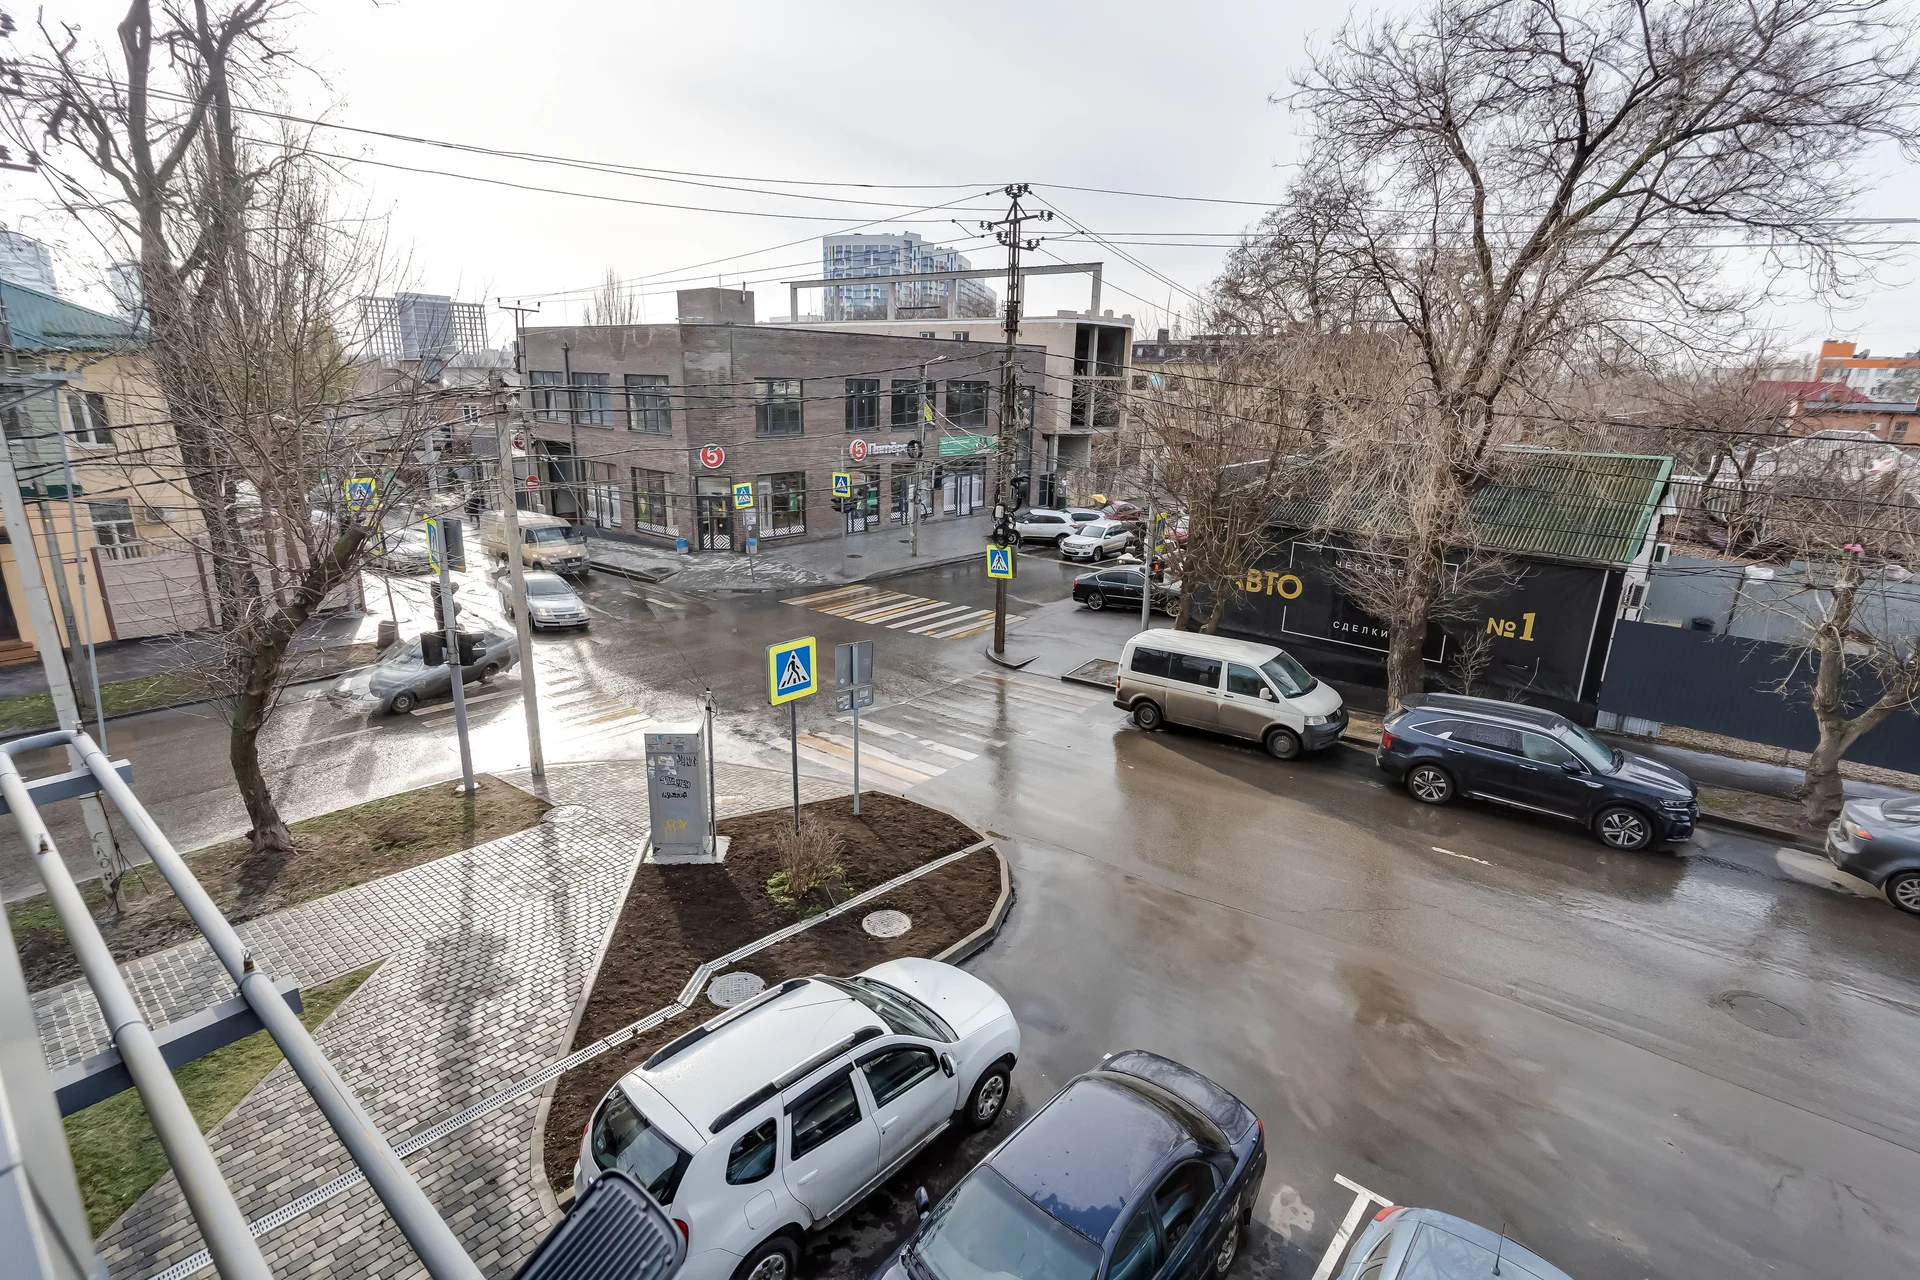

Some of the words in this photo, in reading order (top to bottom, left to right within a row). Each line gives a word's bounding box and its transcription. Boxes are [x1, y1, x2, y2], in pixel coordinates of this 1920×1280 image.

[706, 446, 719, 464] 5
[1332, 621, 1388, 638] СДЕЛКИ
[1486, 612, 1536, 642] №1
